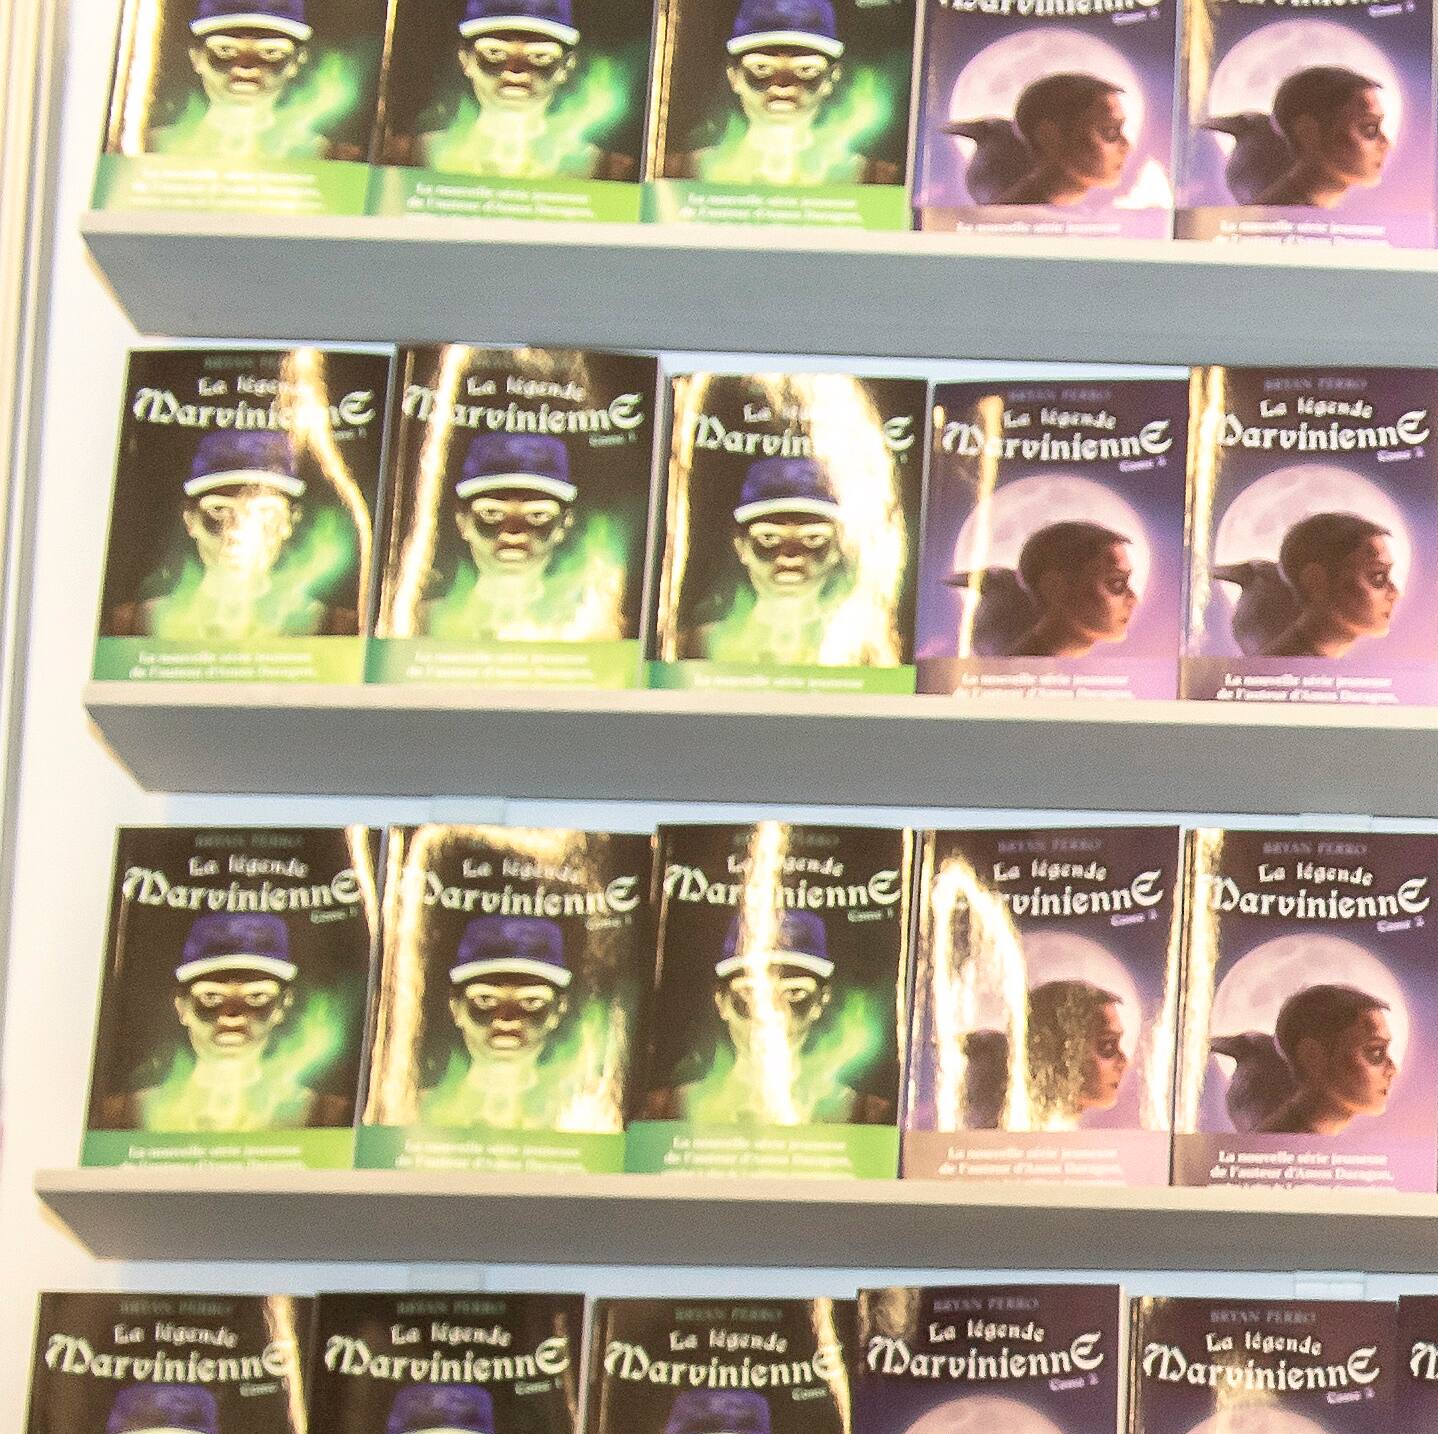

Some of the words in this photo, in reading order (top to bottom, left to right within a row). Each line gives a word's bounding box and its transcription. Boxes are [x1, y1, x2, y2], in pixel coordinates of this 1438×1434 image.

[1260, 400, 1287, 418] La
[1004, 410, 1031, 428] La
[189, 857, 219, 876] La
[993, 862, 1020, 882] La
[1259, 864, 1285, 882] La
[114, 1326, 144, 1345] La
[392, 1326, 420, 1345] La
[929, 1323, 956, 1343] La
[967, 1319, 1044, 1342] légende
[670, 1331, 697, 1351] La
[1206, 1333, 1232, 1351] La
[1245, 1331, 1321, 1356] légende
